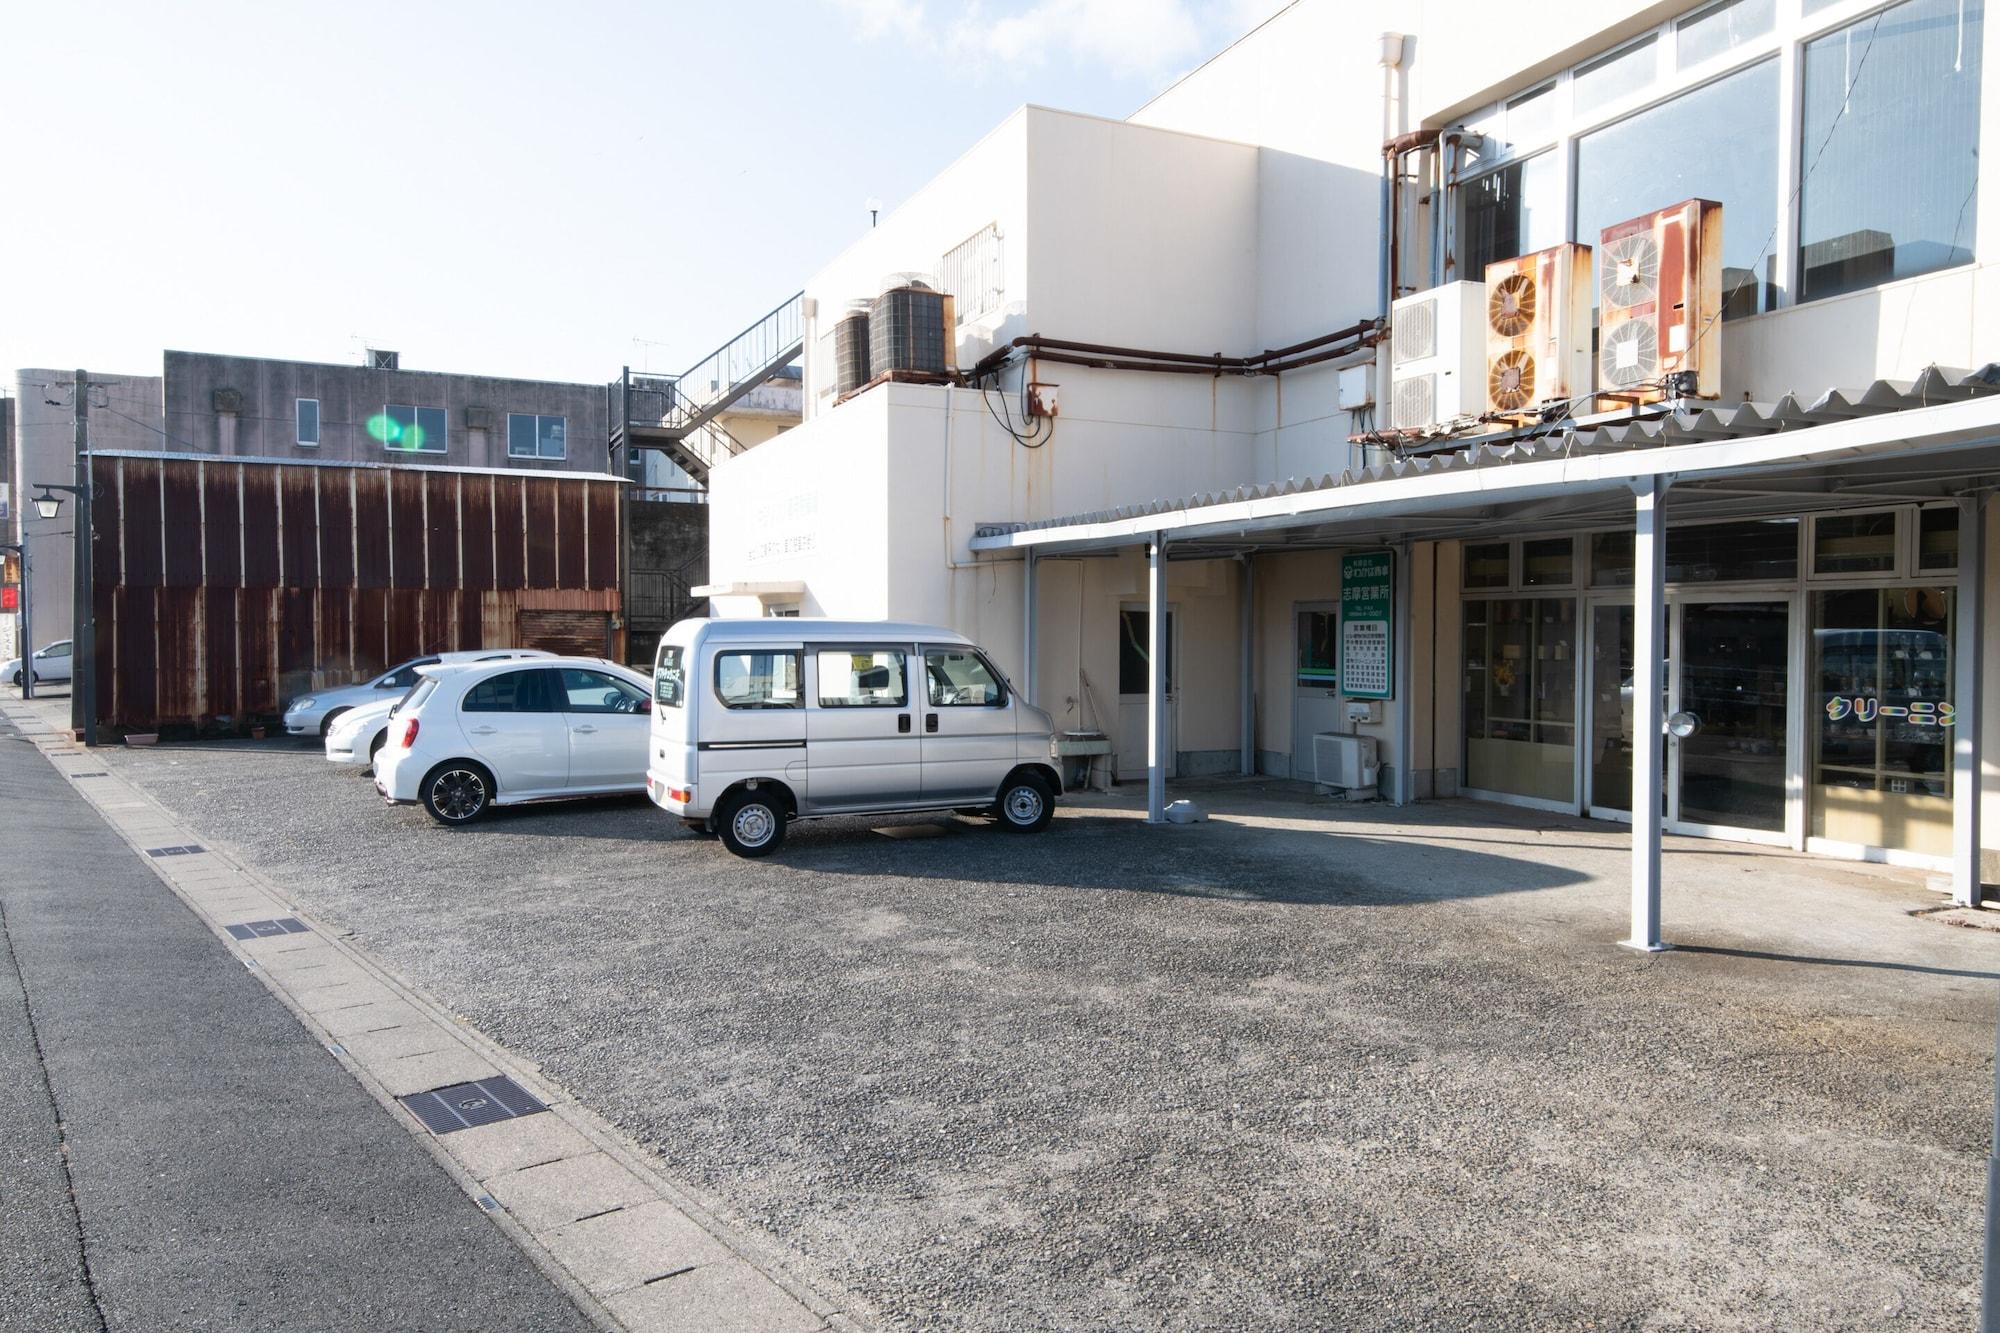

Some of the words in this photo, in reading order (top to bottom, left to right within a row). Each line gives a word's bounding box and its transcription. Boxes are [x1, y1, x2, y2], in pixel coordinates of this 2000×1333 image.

[1343, 585, 1389, 601] 志摩営業所
